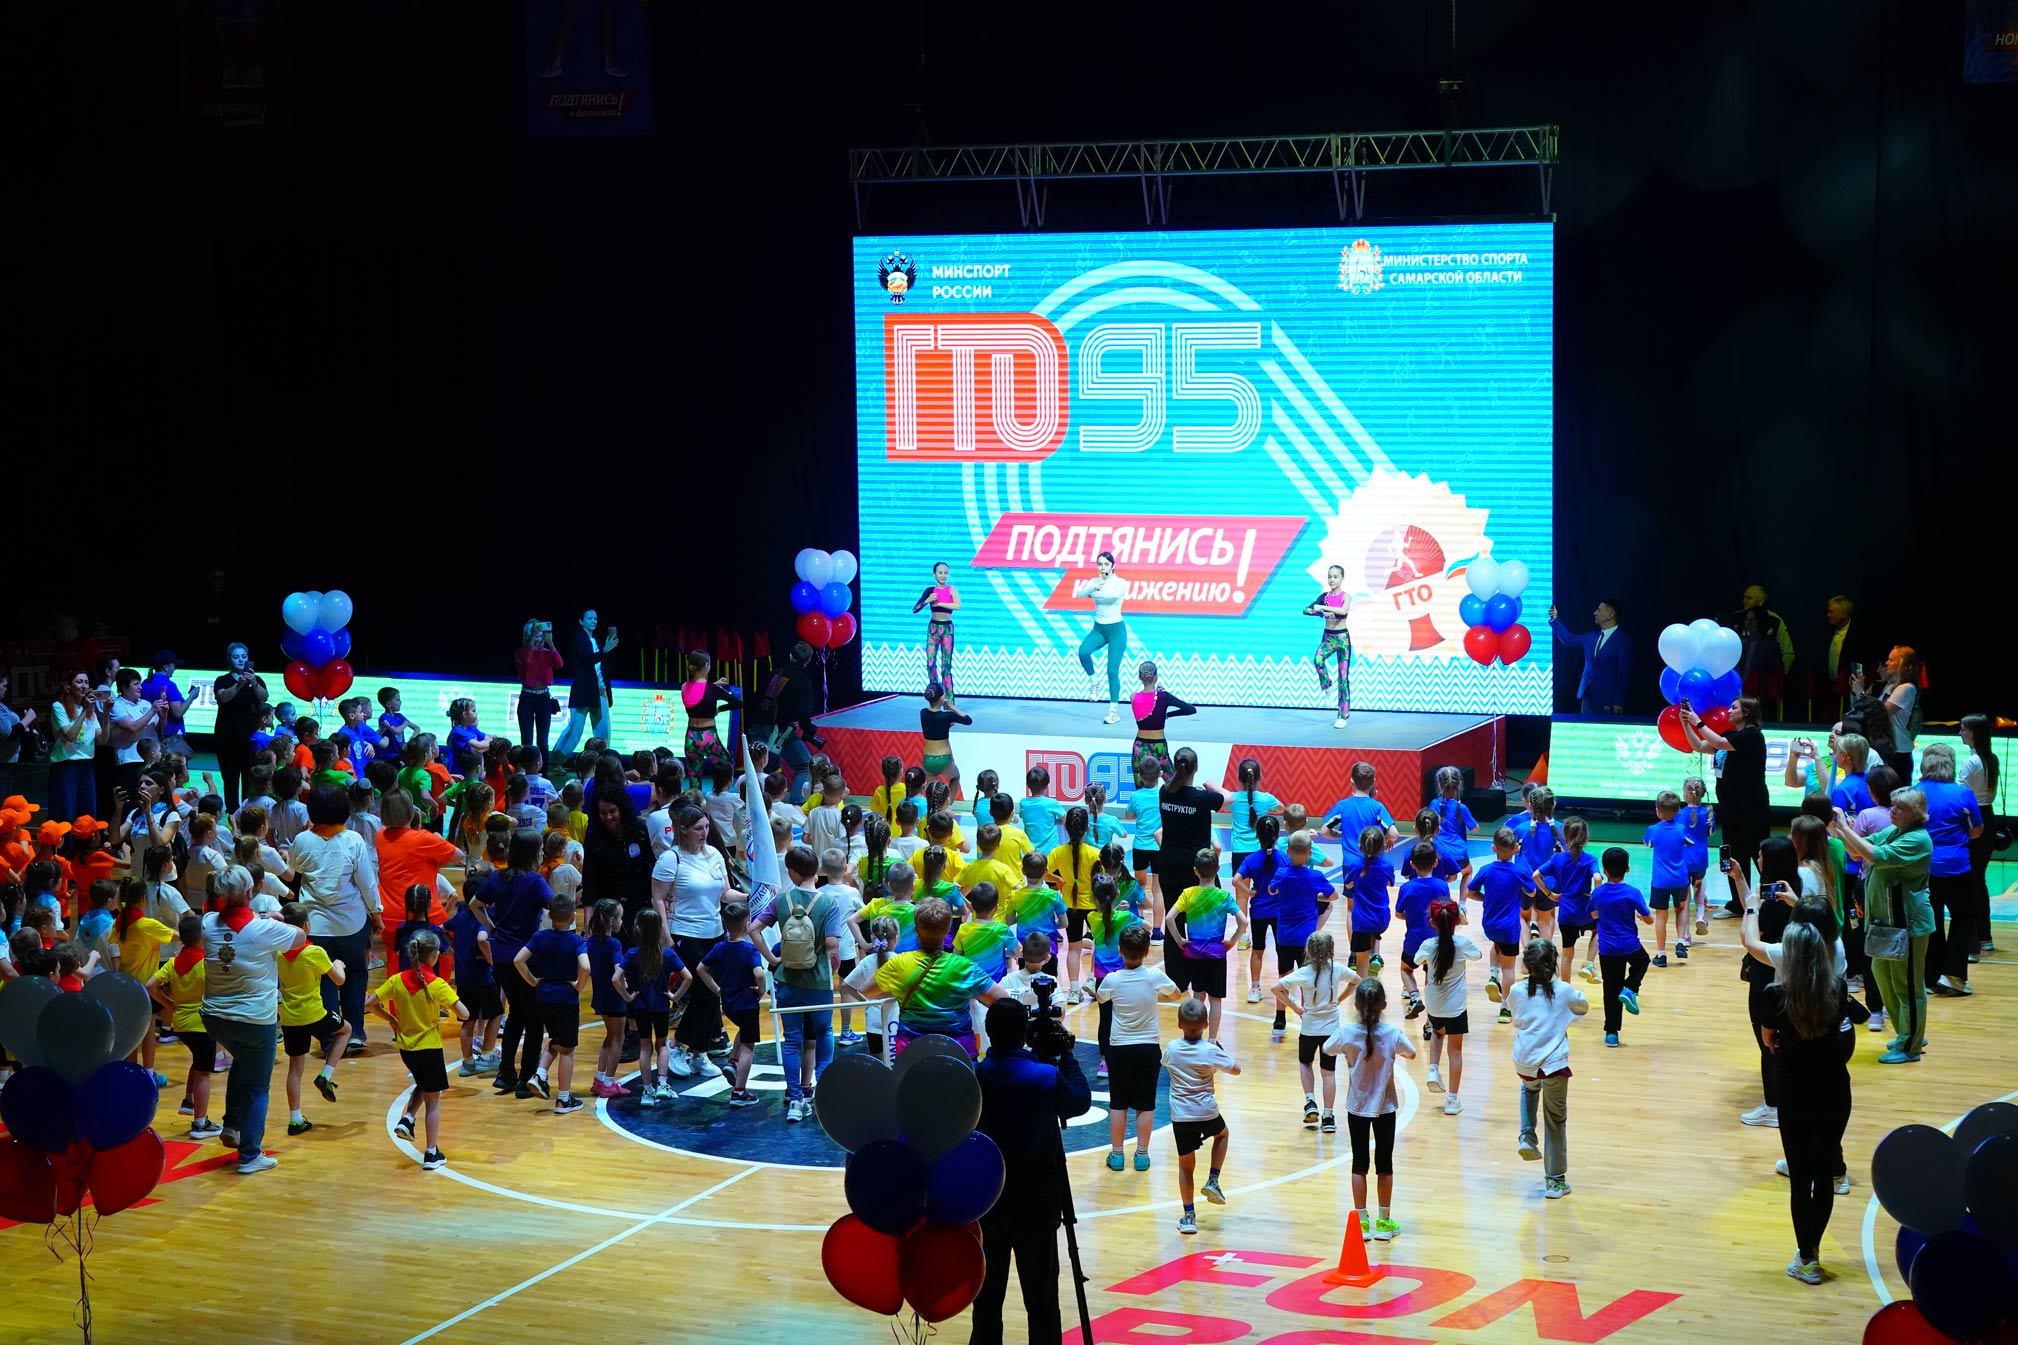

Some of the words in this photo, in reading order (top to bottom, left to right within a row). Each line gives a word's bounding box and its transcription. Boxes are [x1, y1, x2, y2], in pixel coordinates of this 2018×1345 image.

[1383, 253, 1479, 267] МИНИСТЕРСТВО
[1481, 252, 1529, 266] СПОРТА
[932, 264, 1011, 279] МИНСПОРТ
[1389, 270, 1463, 285] САМАРСКОЙ
[1467, 271, 1523, 284] ОБЛАСТИ
[932, 285, 992, 299] РОССИИ
[1392, 584, 1433, 611] ГТО
[1103, 1249, 1684, 1345] FON
